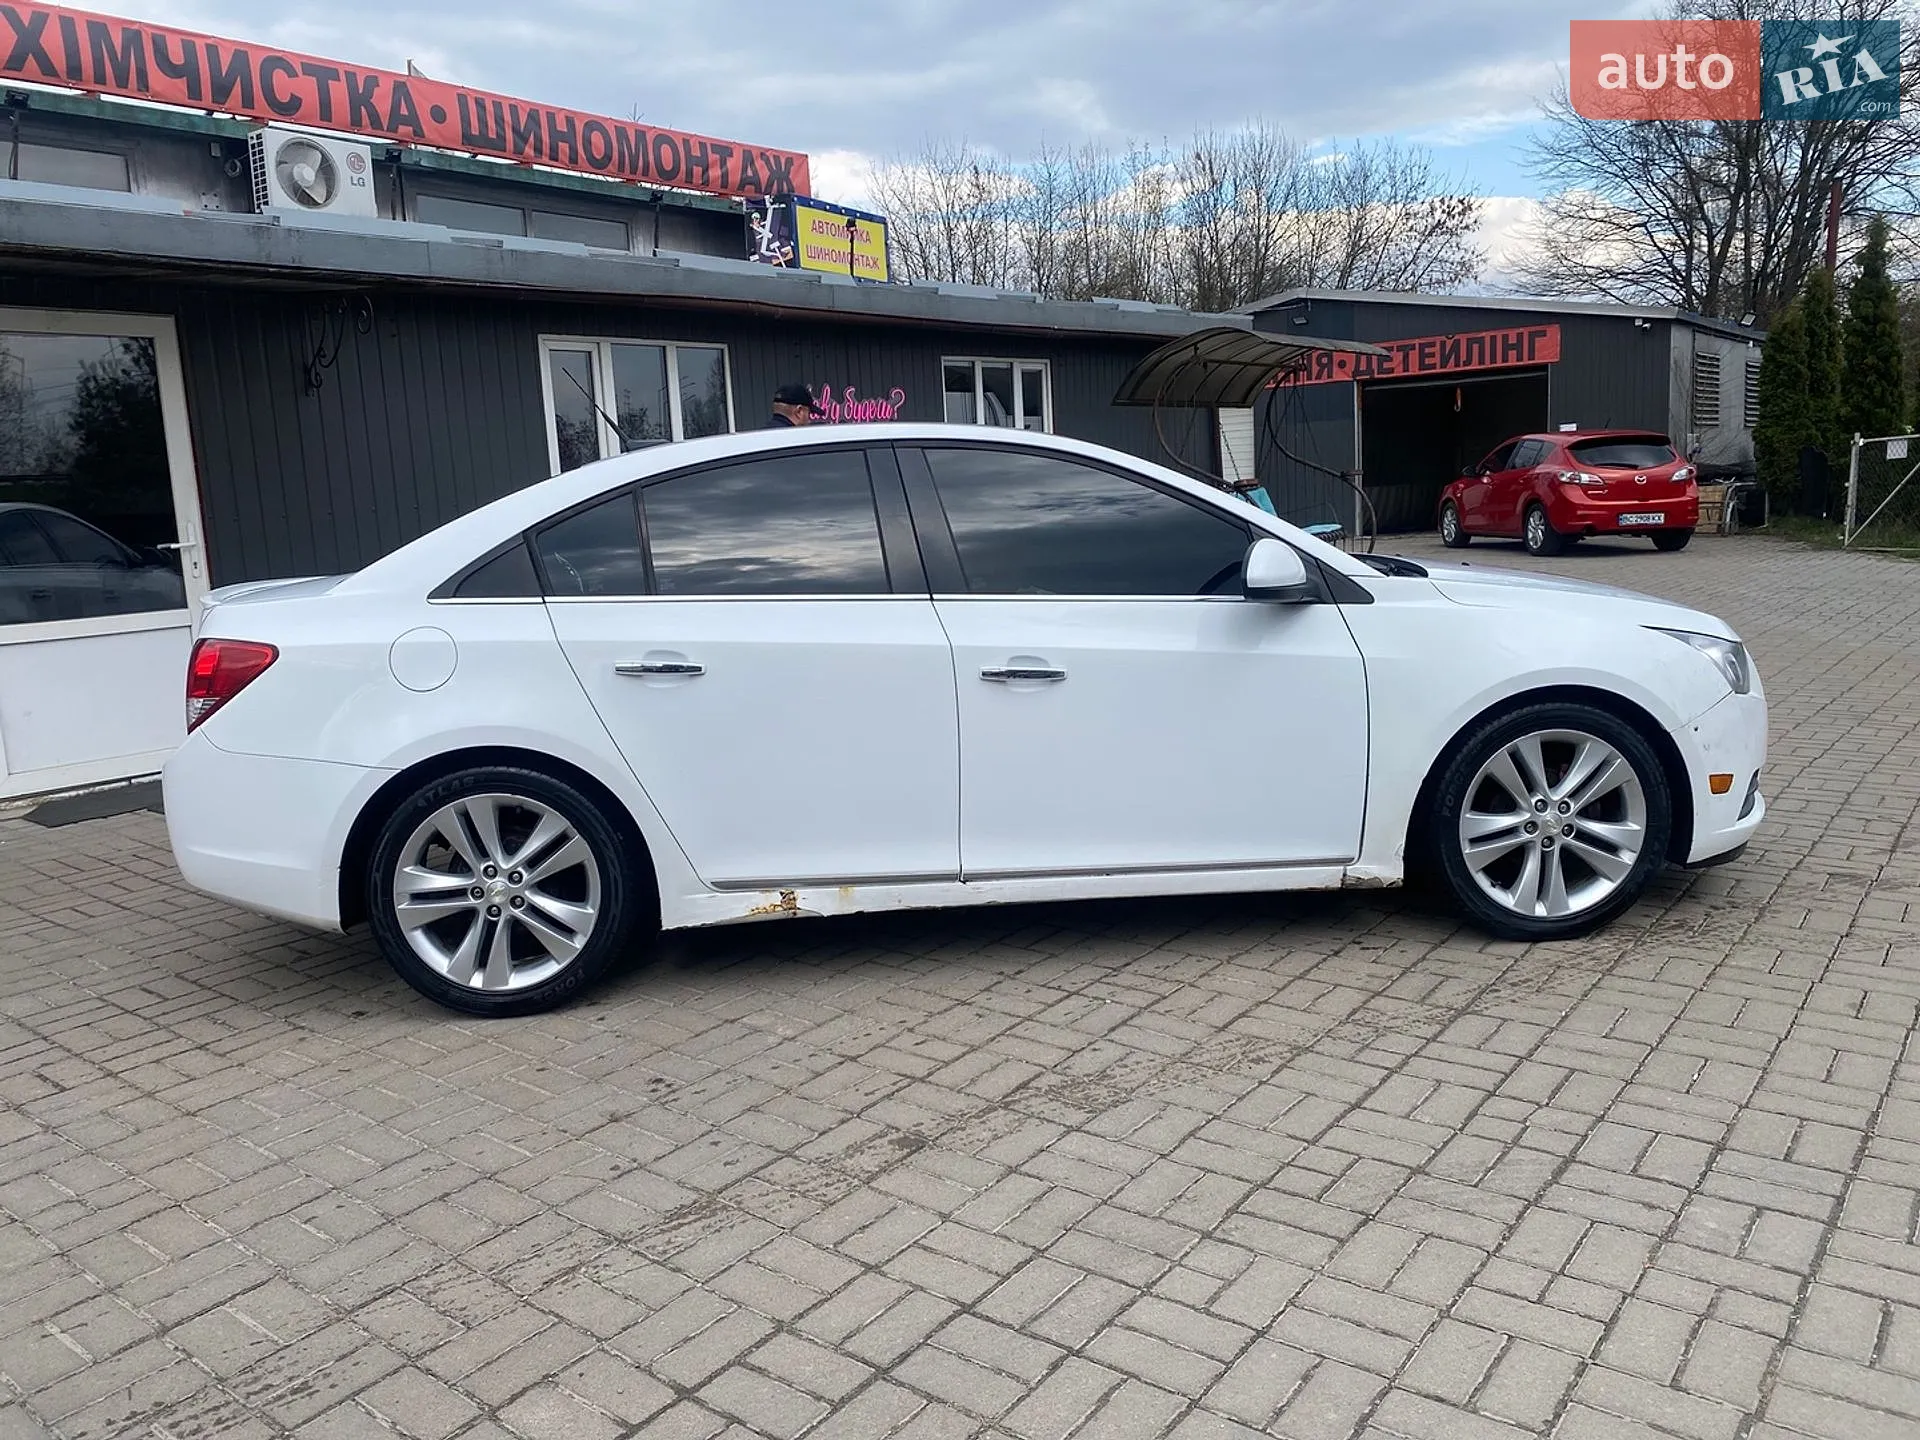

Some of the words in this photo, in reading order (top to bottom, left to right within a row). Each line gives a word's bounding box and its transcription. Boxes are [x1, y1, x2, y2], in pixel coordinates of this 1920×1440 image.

[0, 4, 425, 138] ХІМЧИСТКА
[457, 92, 796, 194] ШИНОМОНТАЖ
[350, 176, 366, 187] LG
[806, 244, 880, 270] ШИНОМОНТАЖ
[1352, 330, 1547, 379] ДЕТЕЙЛІНГ
